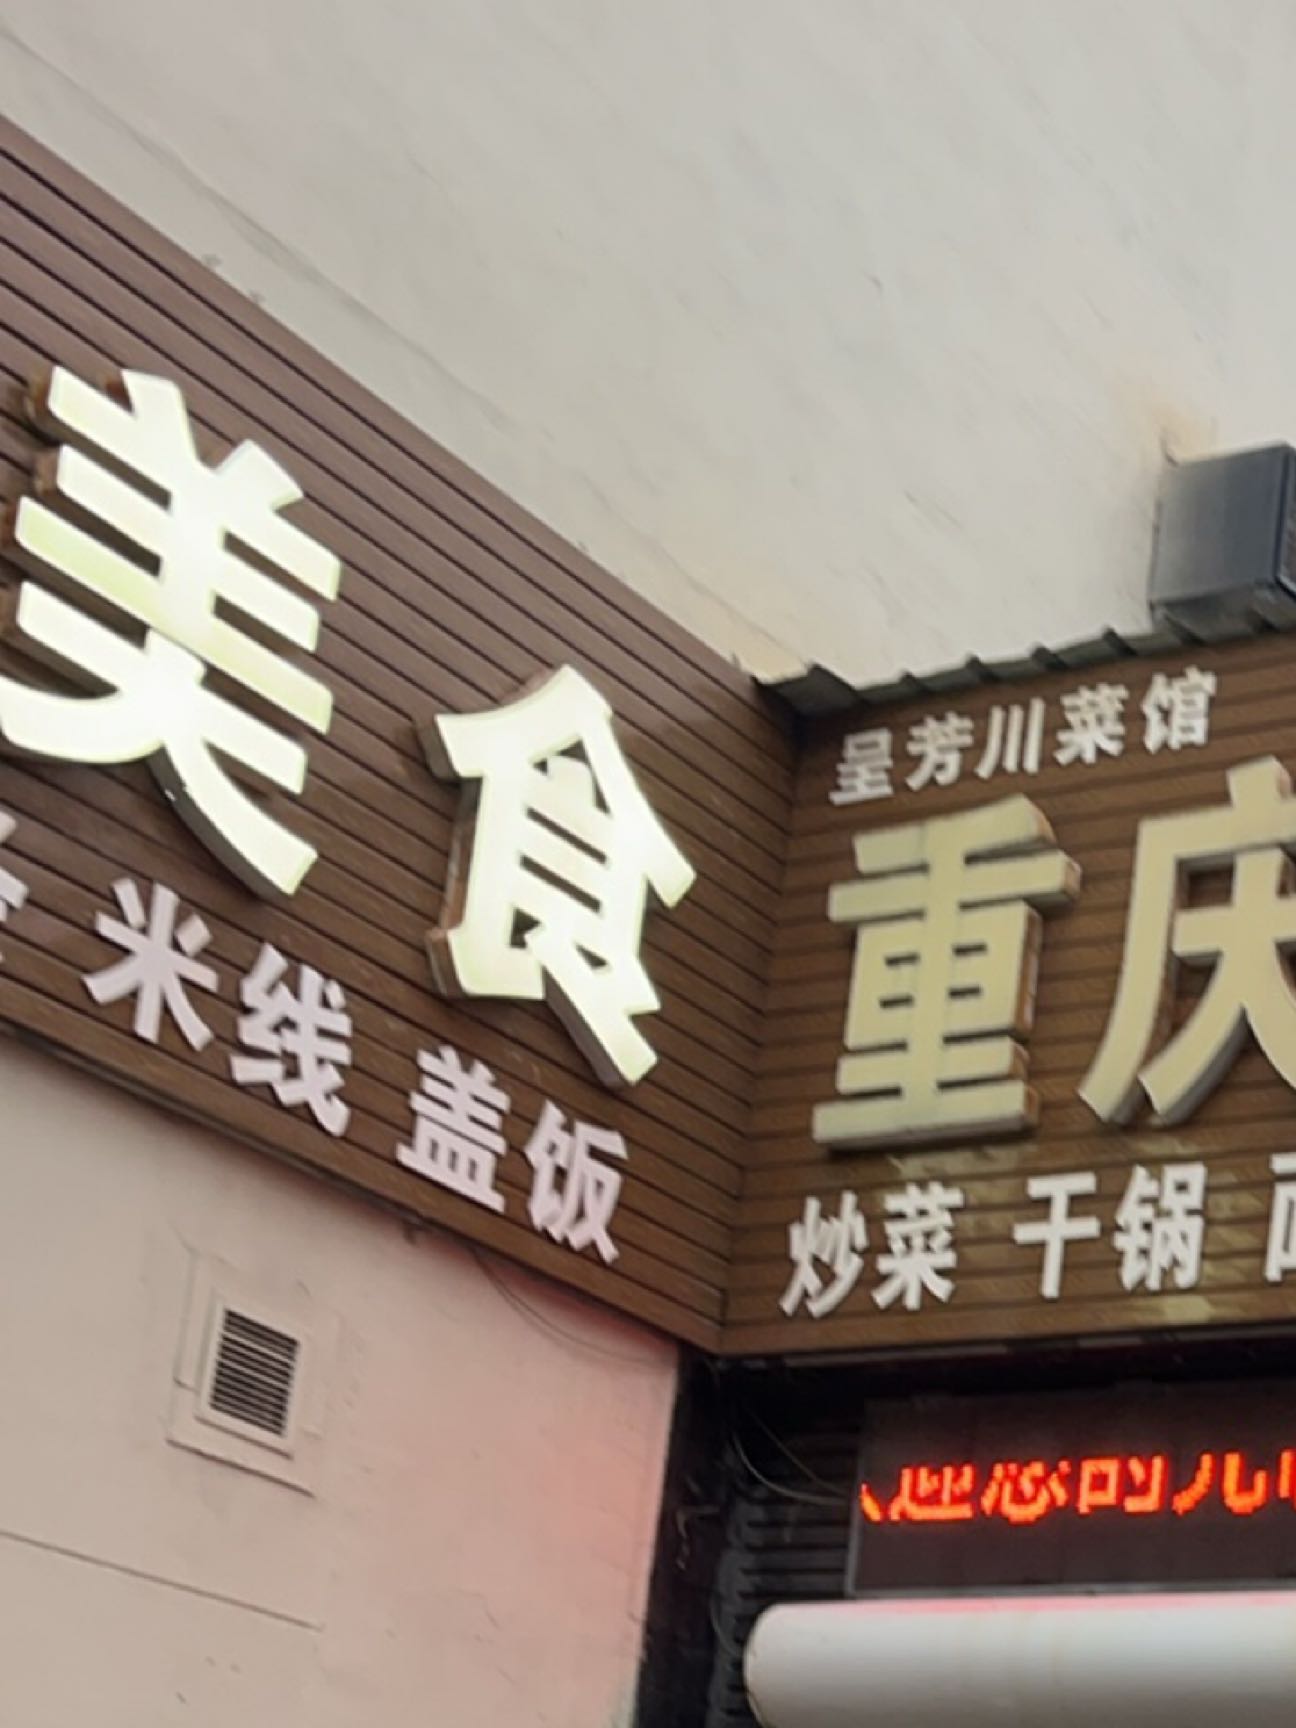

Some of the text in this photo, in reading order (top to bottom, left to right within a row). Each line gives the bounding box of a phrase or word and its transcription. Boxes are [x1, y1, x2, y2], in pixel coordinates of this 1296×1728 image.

[0, 364, 696, 1087] 美食
[829, 665, 1218, 805] 呈芳川菜馆
[82, 877, 353, 1136] 米线
[396, 1046, 630, 1263] 盖饭
[780, 1180, 966, 1319] 炒菜
[1012, 1162, 1207, 1299] 干锅
